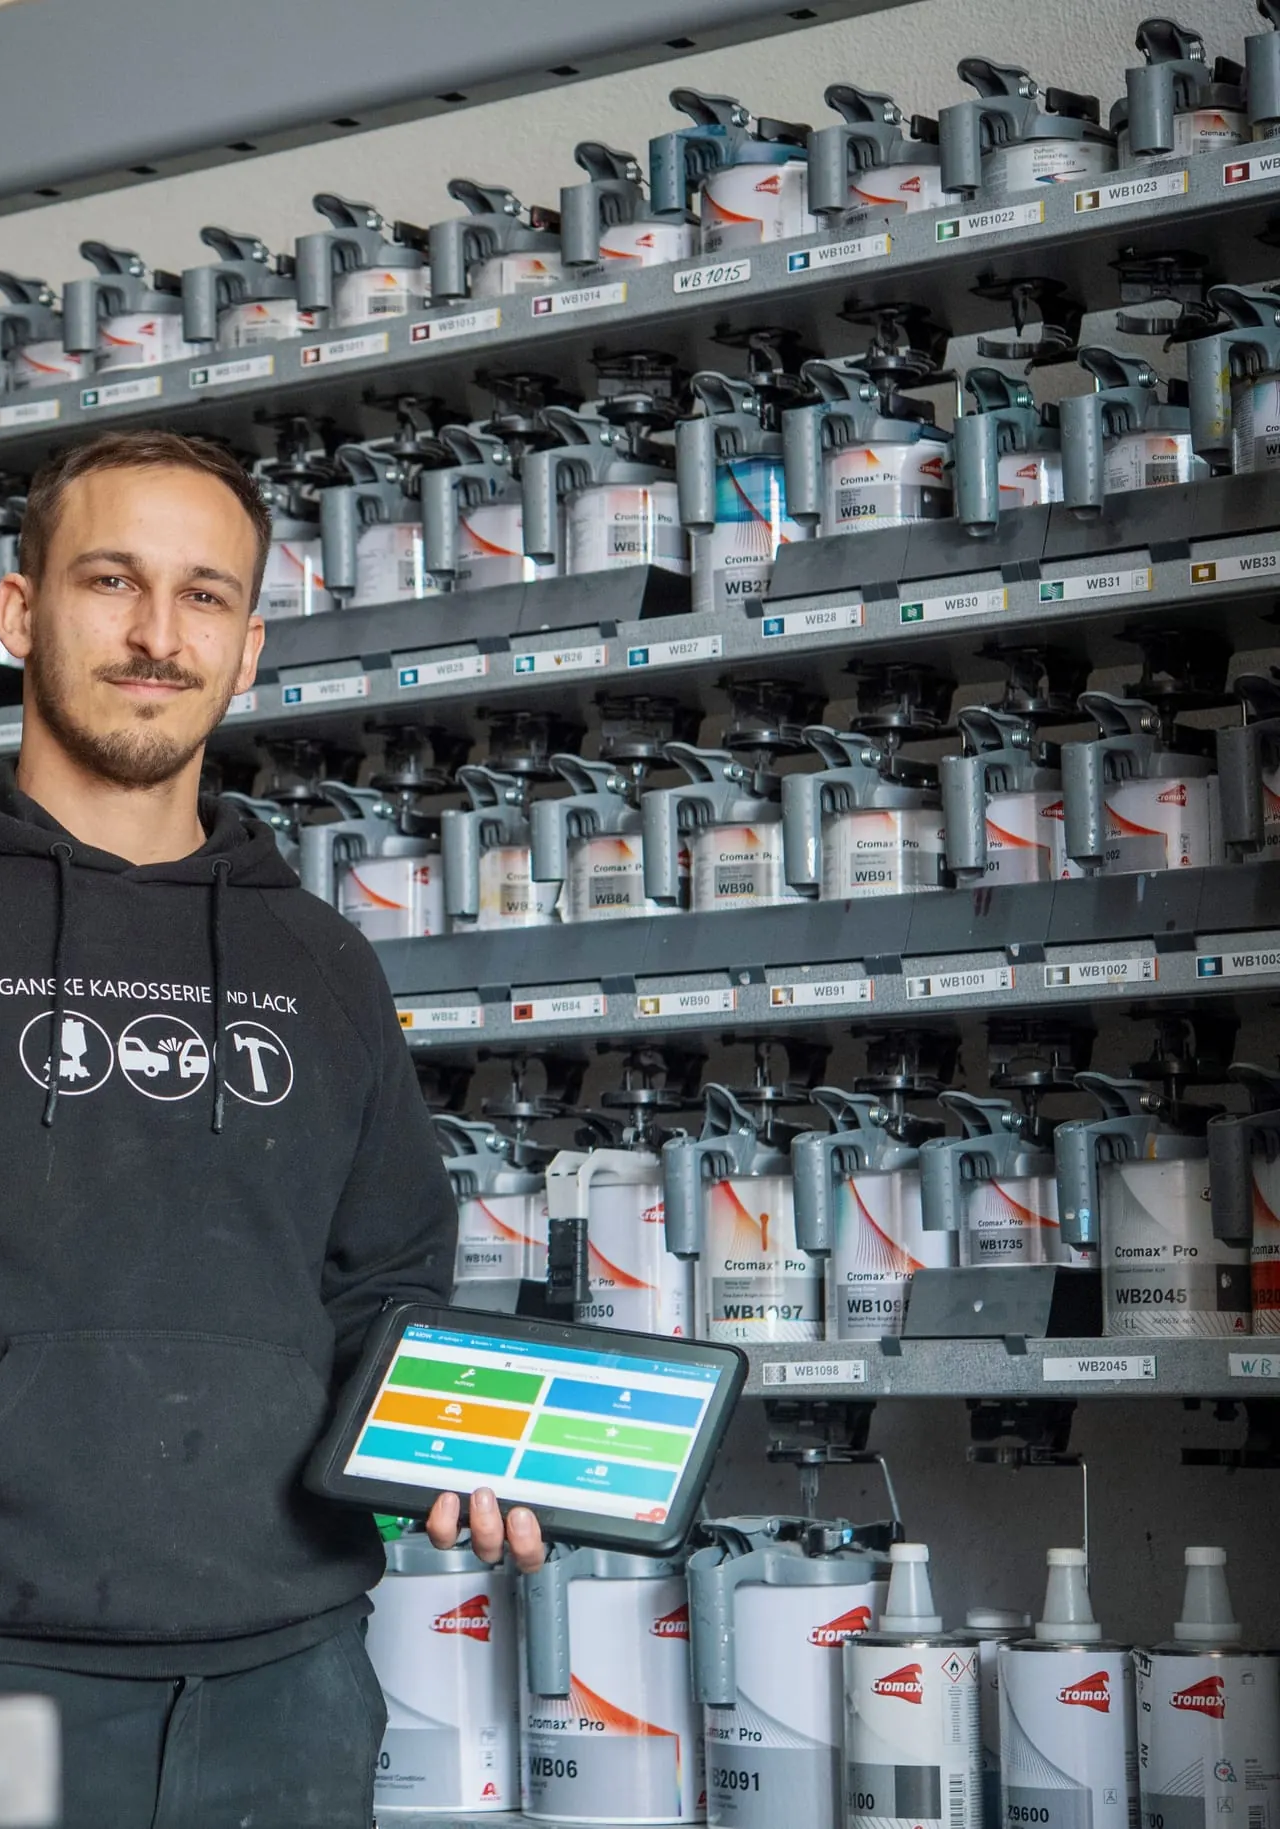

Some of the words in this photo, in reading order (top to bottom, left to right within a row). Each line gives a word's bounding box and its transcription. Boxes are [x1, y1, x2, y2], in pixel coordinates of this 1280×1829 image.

[1108, 180, 1158, 200] WB1023
[968, 210, 1015, 229] WB1022
[818, 243, 862, 260] WB1021
[560, 290, 601, 305] WB1014
[840, 504, 877, 518] WB28
[1239, 556, 1277, 571] WB33
[724, 580, 771, 596] WB27
[1086, 576, 1121, 590] WB31
[944, 596, 979, 611] WB30
[805, 611, 837, 626] WB28
[669, 642, 699, 656] WB27
[902, 839, 920, 849] Pro
[855, 869, 893, 883] WB91
[718, 882, 754, 895] WB90
[594, 893, 630, 905] WB84
[1078, 964, 1128, 978] WB1002
[939, 974, 986, 988] WB1001
[89, 979, 212, 1003] KAROSSERIE
[227, 990, 248, 1005] ND
[252, 992, 299, 1015] LACK
[814, 985, 845, 998] WB91
[551, 1000, 581, 1012] WB84
[679, 995, 710, 1007] WB90
[979, 1239, 1024, 1250] WB1735
[1114, 1244, 1161, 1258] Cromax
[1173, 1244, 1198, 1258] Pro
[464, 1253, 502, 1264] WB1041
[724, 1259, 774, 1272] Cromax
[784, 1259, 806, 1272] Pro
[598, 1277, 615, 1287] Pro
[846, 1271, 885, 1281] Cromax
[894, 1271, 914, 1281] Pro
[1115, 1288, 1188, 1305] WB2045
[579, 1304, 614, 1318] B1050
[794, 1364, 840, 1377] WB1098
[1078, 1360, 1128, 1373] WB2045
[430, 1614, 491, 1630] Cromax
[651, 1618, 689, 1634] Crom
[808, 1626, 863, 1642] Crom
[871, 1679, 923, 1694] Cromax
[1058, 1687, 1111, 1702] Cromax
[1170, 1692, 1225, 1708] Cromax
[579, 1717, 605, 1732] Pro
[739, 1727, 762, 1742] Pro
[528, 1756, 578, 1779] WB06
[712, 1766, 760, 1792] B2091
[849, 1791, 875, 1810] 100
[1007, 1804, 1050, 1824] Z9600
